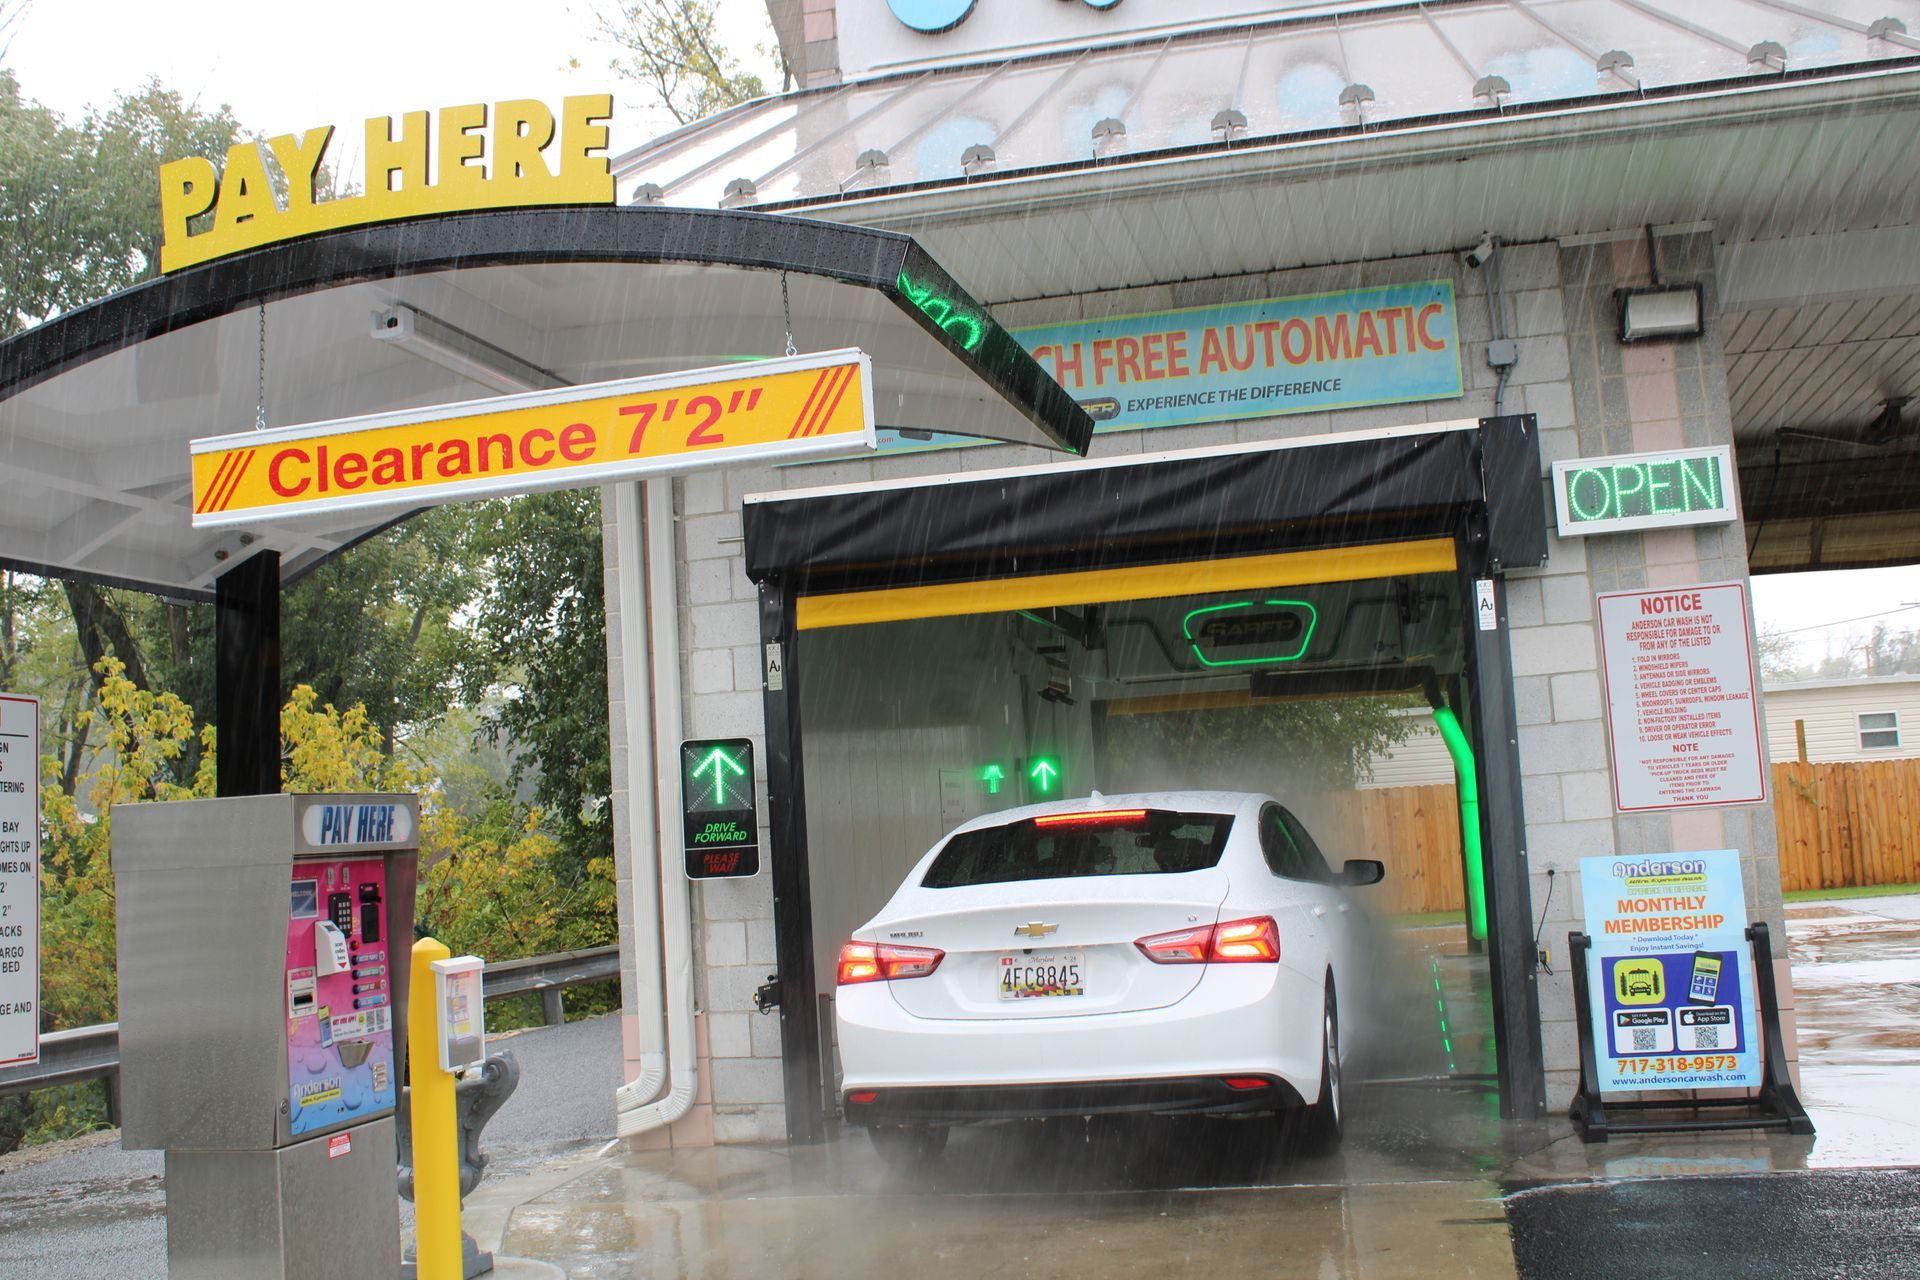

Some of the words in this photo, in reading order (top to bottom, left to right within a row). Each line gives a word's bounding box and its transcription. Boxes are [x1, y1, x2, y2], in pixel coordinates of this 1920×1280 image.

[160, 125, 336, 252] PAY
[365, 94, 614, 200] HERE
[1093, 331, 1190, 386] FREE
[1198, 303, 1446, 374] AUTOMATIC
[1127, 393, 1216, 412] EXPERIENCE
[1219, 387, 1246, 402] THE
[1250, 379, 1341, 400] DIFFERENCE
[268, 422, 597, 497] Clearance
[1570, 456, 1718, 521] OPEN
[1640, 594, 1702, 615] NOTICE
[1632, 619, 1662, 630] ANDERSON
[1663, 617, 1675, 628] CAR
[1676, 616, 1692, 626] WASH
[1694, 615, 1700, 625] IS
[1701, 615, 1713, 624] NOT
[1626, 629, 1664, 641] RESPONSIBLE
[1666, 628, 1677, 638] FOR
[1679, 626, 1702, 637] DAMAGE
[1703, 625, 1711, 635] TO
[1712, 625, 1721, 634] OR
[1639, 642, 1655, 651] FROM
[1657, 640, 1668, 650] ANY
[1670, 640, 1677, 648] OF
[1679, 638, 1690, 647] THE
[1691, 637, 1711, 646] LISTED
[1657, 652, 1680, 661] MIRRORS
[1638, 663, 1669, 671] WINDSHIELD
[1640, 672, 1665, 680] ANTENNAS
[1675, 669, 1686, 677] SIDE
[1687, 668, 1709, 676] MIRRORS
[1640, 681, 1660, 689] VEHICLE
[1662, 679, 1684, 687] BADGING
[1693, 676, 1717, 685] EMBLEMS
[1641, 690, 1658, 698] WHEEL
[1659, 689, 1678, 697] COVERS
[1709, 685, 1721, 693] CAPS
[1704, 694, 1724, 702] WINDOW
[1725, 692, 1749, 700] LEAKAGE
[1643, 707, 1663, 716] VEHICLE
[1664, 706, 1687, 714] MOLDING
[1679, 713, 1705, 721] INSTALLED
[1706, 711, 1721, 719] ITEMS
[1645, 725, 1662, 733] DRIVER
[1672, 722, 1698, 731] OPERATOR
[1688, 730, 1709, 738] VEHICLE
[1710, 728, 1732, 736] EFFECTS
[1673, 743, 1699, 752] NOTE
[3, 821, 19, 833] BAY
[320, 806, 353, 844] PAY
[357, 805, 395, 842] HERE
[705, 822, 736, 833] DRIVE
[694, 831, 747, 843] FORWARD
[21, 841, 31, 852] UP
[704, 853, 740, 864] PLEASE
[20, 862, 31, 873] ON
[709, 863, 736, 873] WAIT
[1612, 859, 1706, 878] Anderson
[1617, 896, 1706, 913] MONTHLY
[1605, 914, 1725, 934] MEMBERSHIP
[1637, 935, 1672, 943] Download
[1630, 944, 1649, 952] Enjoy
[1676, 941, 1704, 950] Savings!
[3, 961, 20, 973] BED
[1003, 965, 1079, 989] 4FC8845
[14, 1001, 32, 1014] AND
[1653, 1016, 1665, 1024] Play
[1617, 1056, 1737, 1075] 717-318-9573
[1612, 1073, 1747, 1086] www.andersoncarwash.com
[294, 1076, 341, 1097] Anderson
